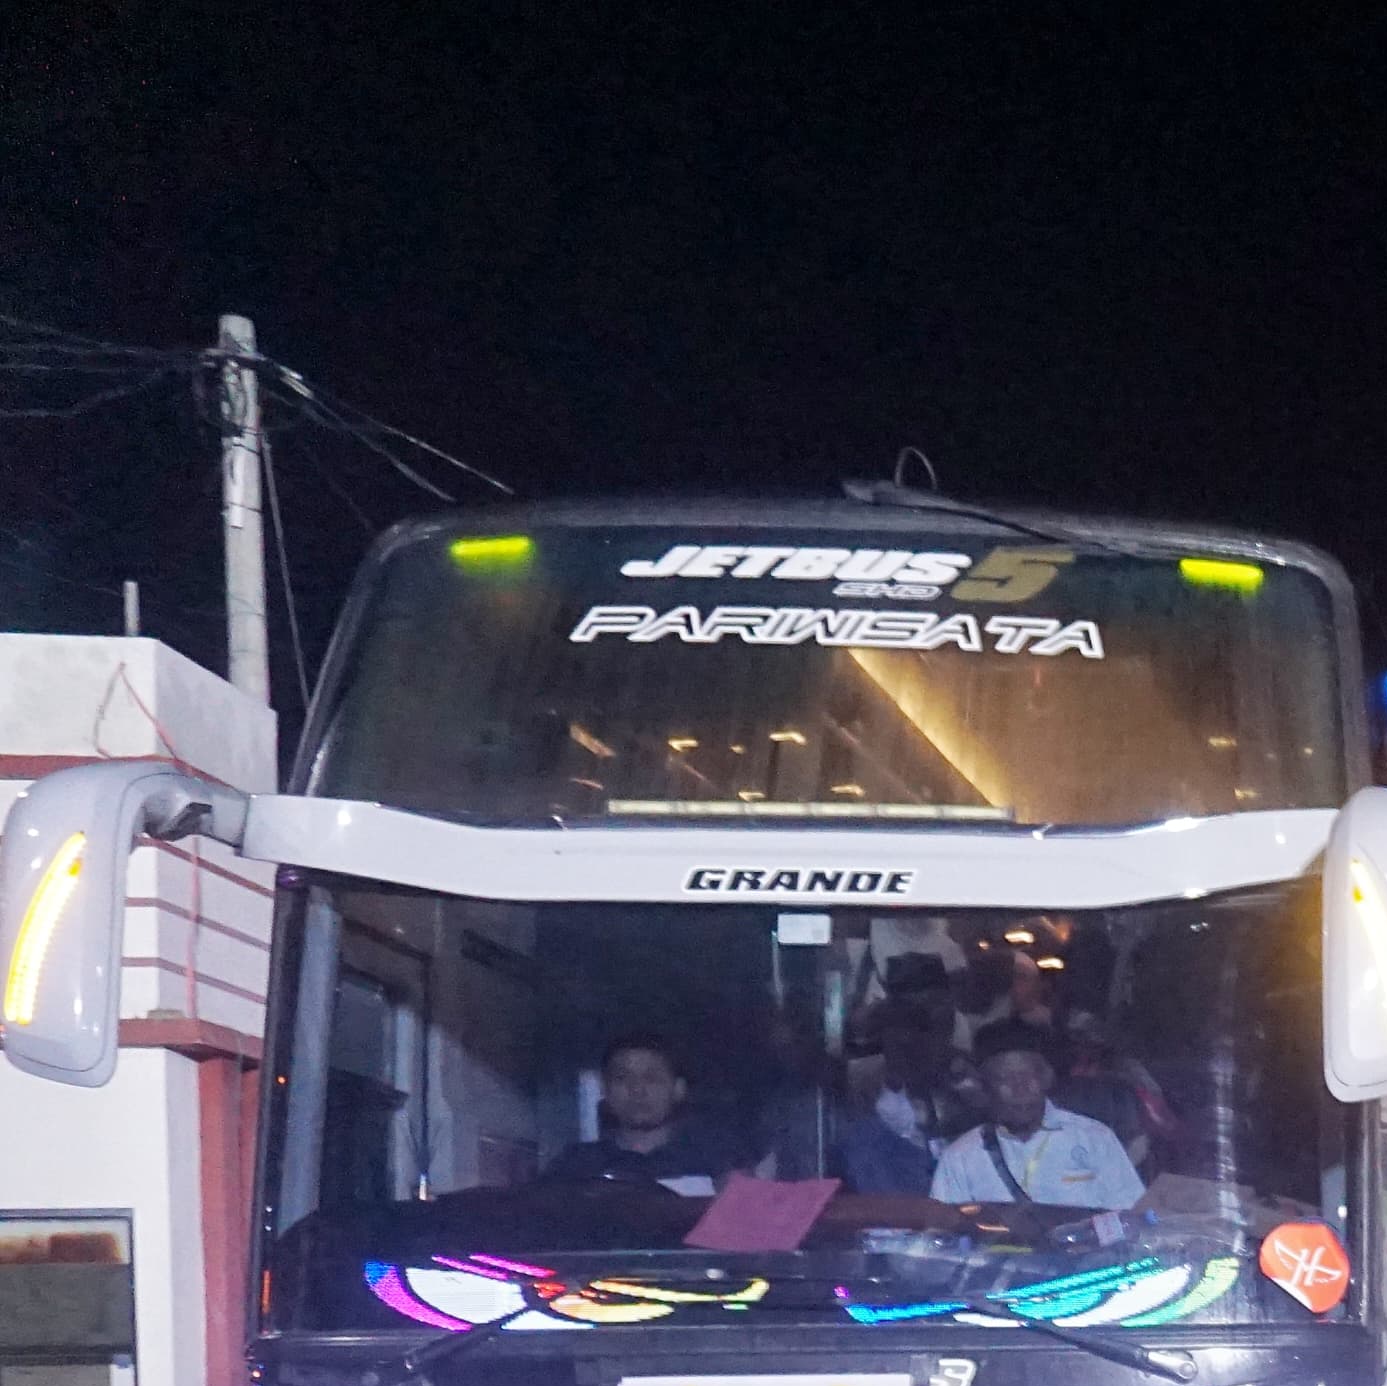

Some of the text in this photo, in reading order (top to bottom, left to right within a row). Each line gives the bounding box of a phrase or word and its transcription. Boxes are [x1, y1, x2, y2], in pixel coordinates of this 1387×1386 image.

[620, 545, 1076, 602] JETBUS 5
[568, 605, 1105, 660] PARIWISATA
[685, 868, 915, 894] GRANDE
